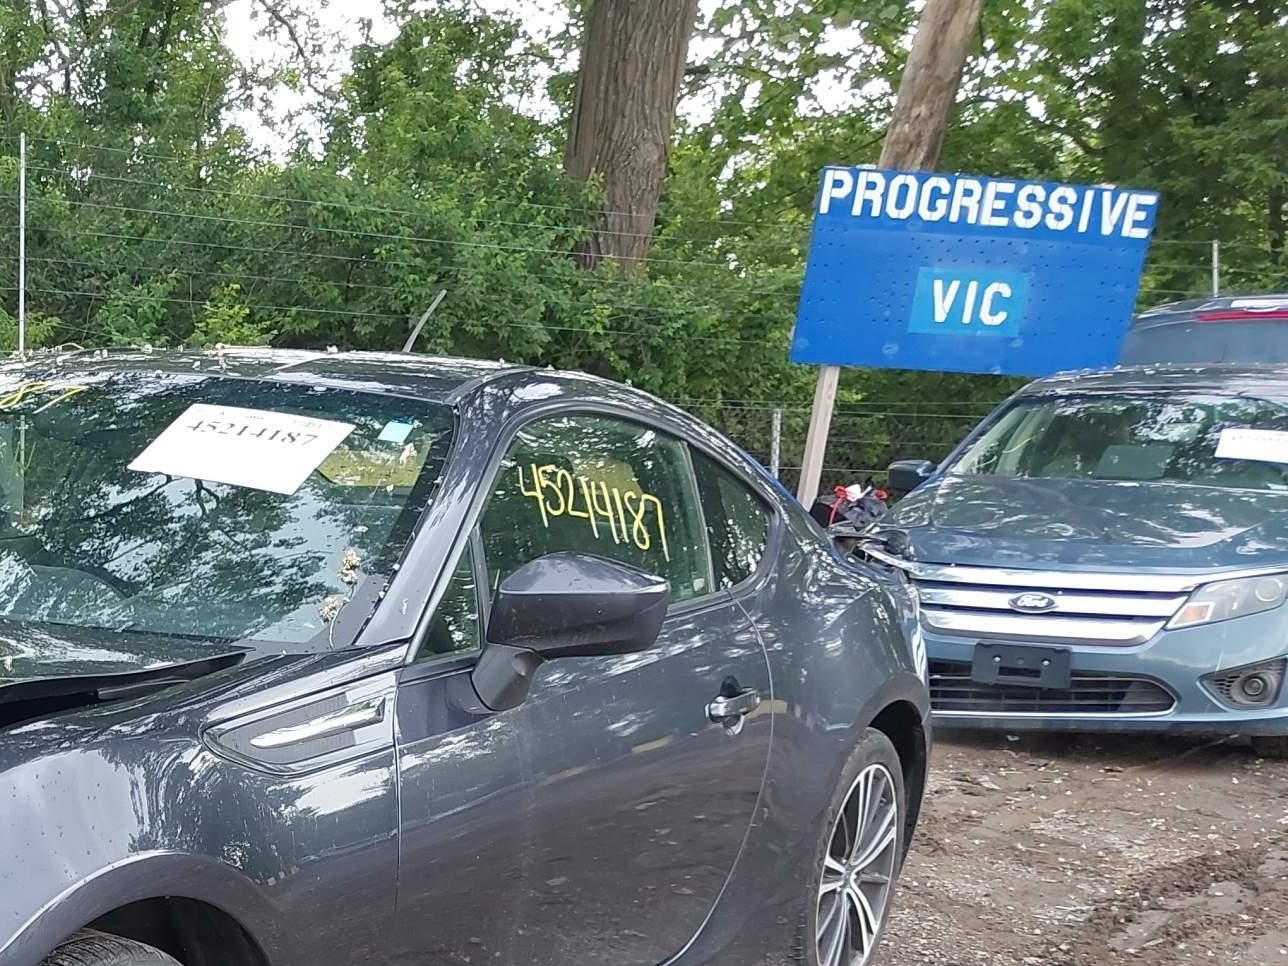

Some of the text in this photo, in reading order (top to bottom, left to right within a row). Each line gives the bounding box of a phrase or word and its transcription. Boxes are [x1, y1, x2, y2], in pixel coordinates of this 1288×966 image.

[818, 169, 1158, 239] PROGRESSIVE
[932, 278, 1012, 326] VIC
[186, 419, 320, 446] 45214187
[517, 462, 670, 562] 45214187
[1016, 594, 1049, 608] Ford
